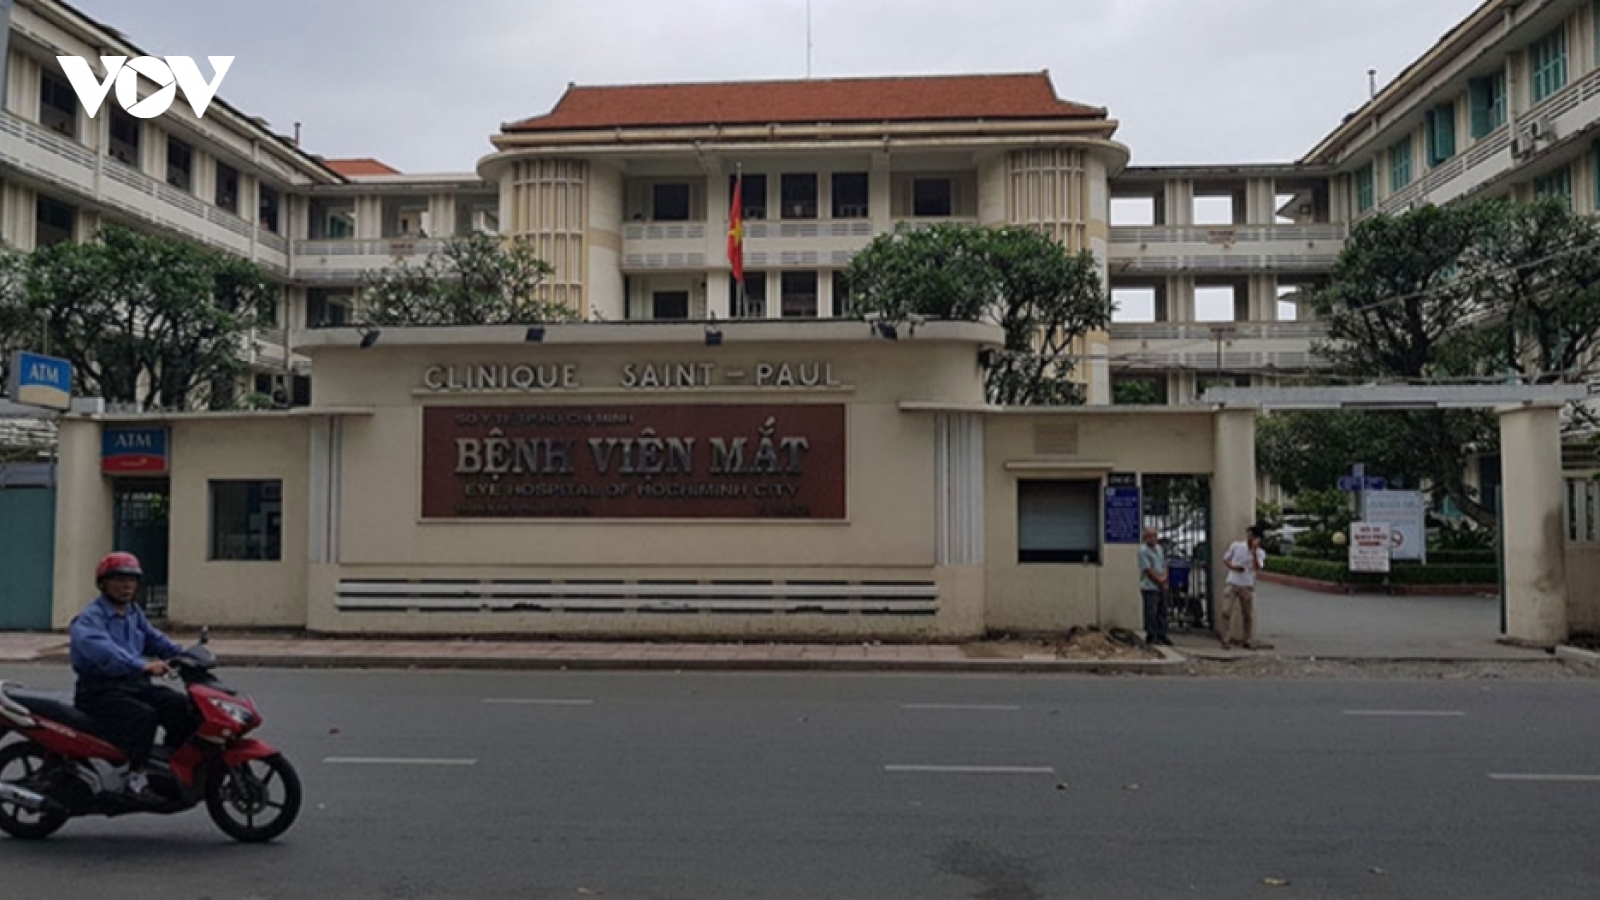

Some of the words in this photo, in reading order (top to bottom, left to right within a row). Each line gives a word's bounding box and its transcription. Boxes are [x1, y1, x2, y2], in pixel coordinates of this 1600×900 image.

[28, 362, 60, 384] ATM
[424, 364, 580, 390] CLINIQUE
[621, 362, 715, 387] SAINT
[756, 362, 841, 386] PAUL
[114, 432, 152, 448] ATM
[455, 427, 575, 480] BỆNH
[588, 427, 696, 480] VIỆN
[709, 415, 809, 474] MẮT
[465, 484, 500, 497] EYE
[506, 484, 599, 497] HOSPITAL
[606, 484, 630, 497] OF
[637, 484, 747, 498] HOCHIMINH
[754, 484, 798, 498] CITY
